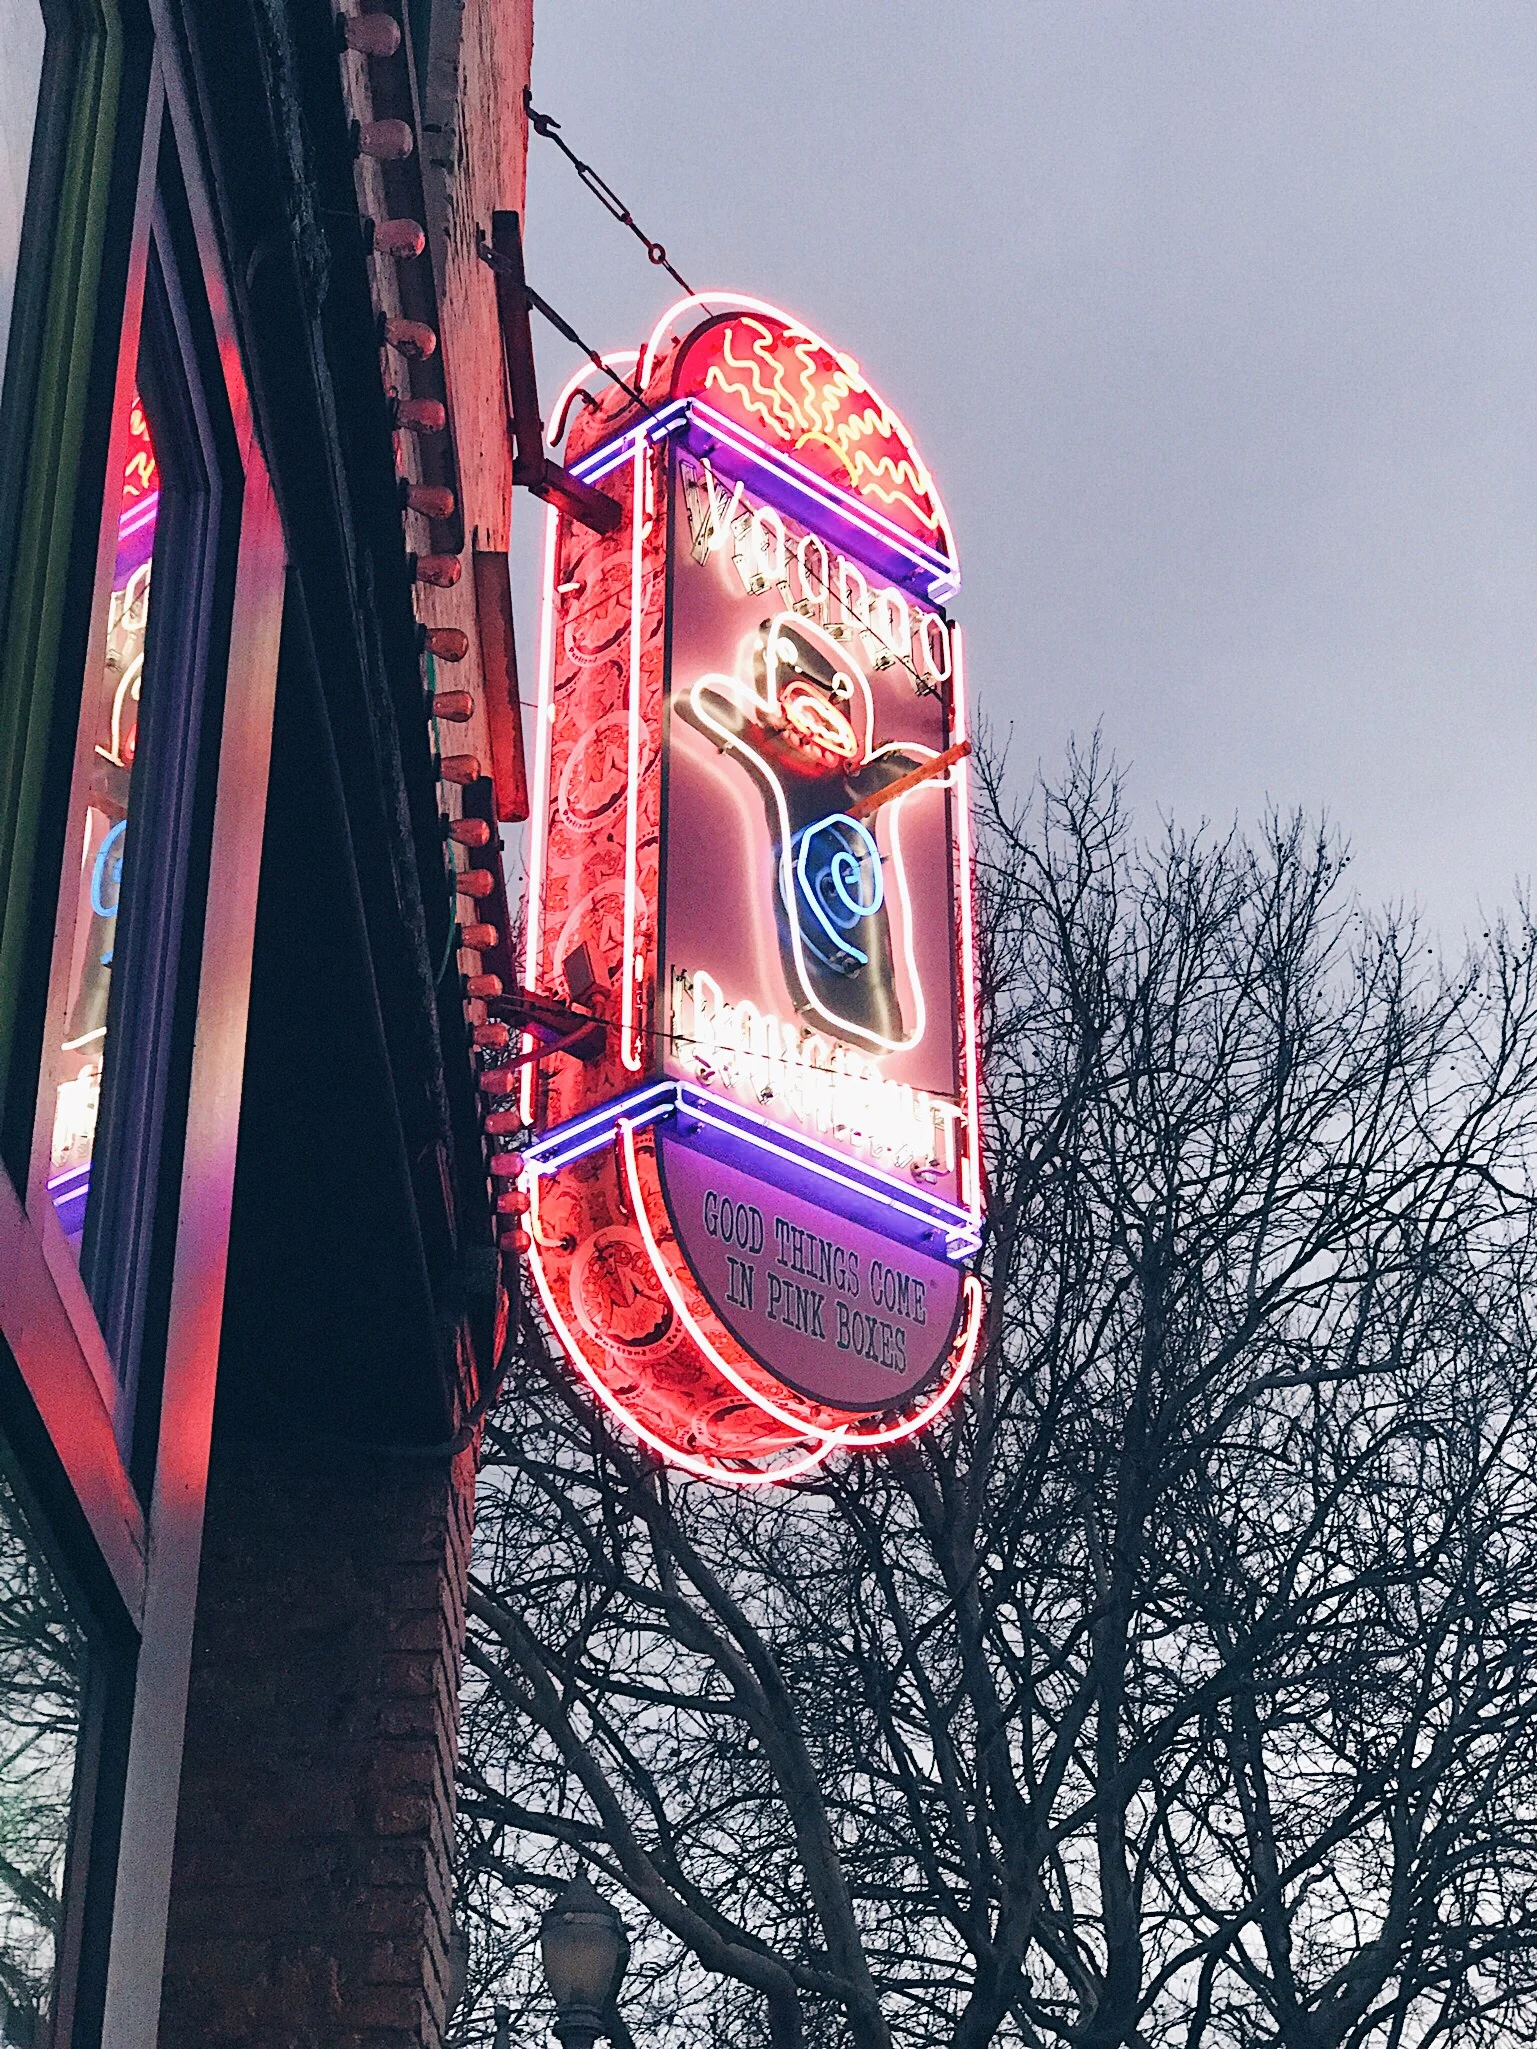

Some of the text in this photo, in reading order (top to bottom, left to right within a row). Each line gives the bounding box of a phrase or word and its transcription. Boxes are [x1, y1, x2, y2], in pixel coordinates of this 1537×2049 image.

[703, 1190, 927, 1326] GOOD THINGS COME
[725, 1256, 755, 1311] IN
[765, 1271, 826, 1341] PINK
[835, 1300, 907, 1375] BOXES
